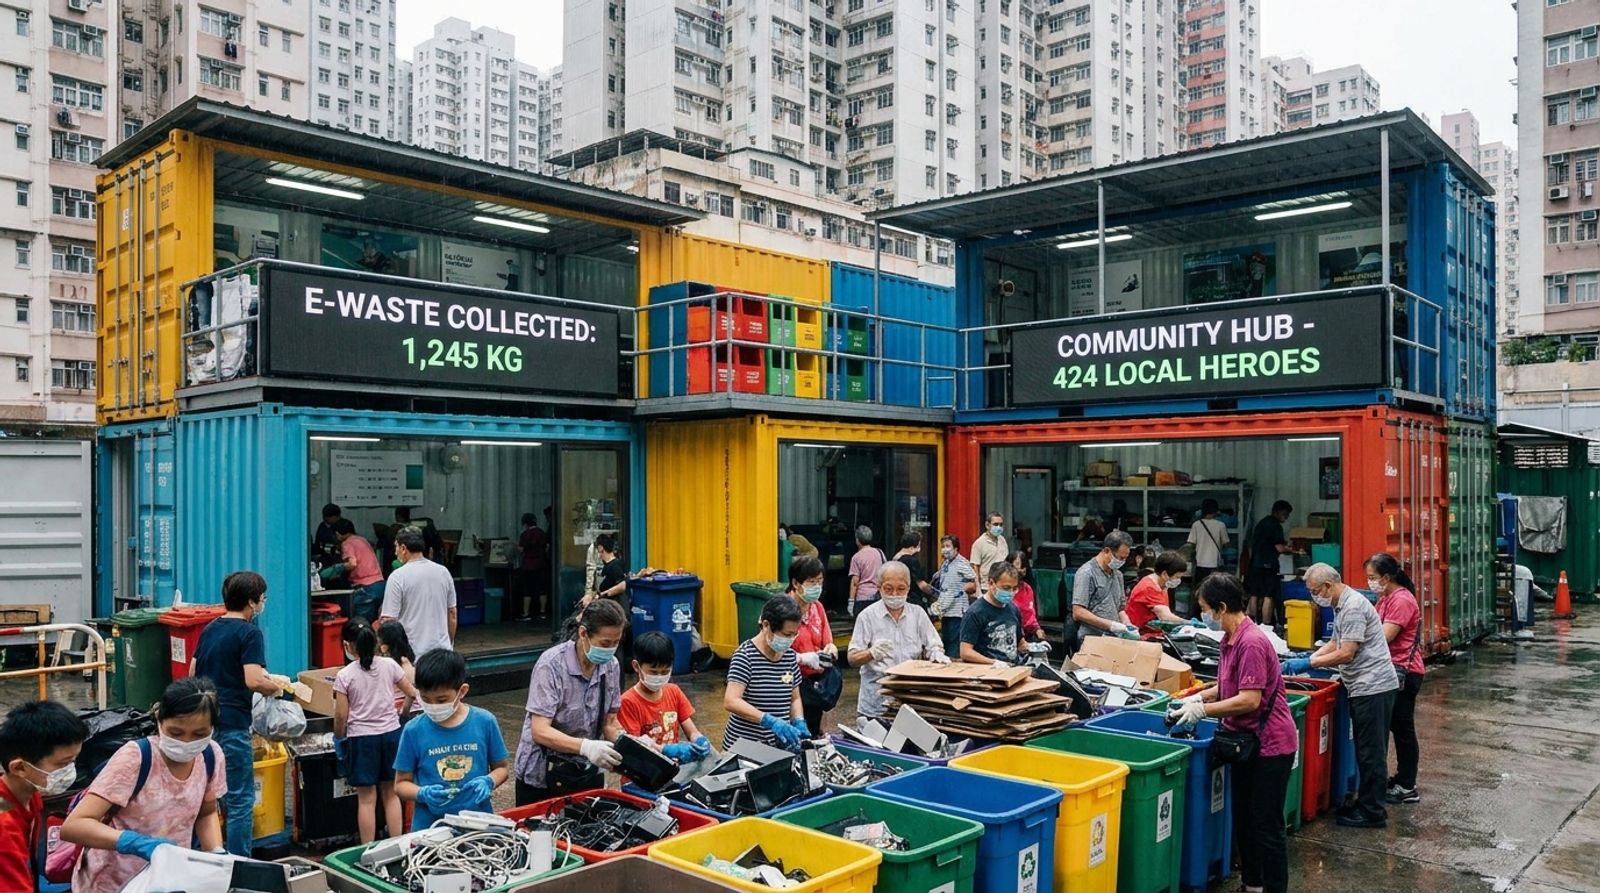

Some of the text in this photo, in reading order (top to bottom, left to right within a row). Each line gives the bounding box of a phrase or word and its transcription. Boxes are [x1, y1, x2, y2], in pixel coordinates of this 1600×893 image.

[305, 286, 597, 343] E-WASTE COLLECTED:
[1057, 320, 1224, 358] COMMUNITY
[1231, 314, 1294, 344] HUB
[402, 337, 523, 373] 1,245 KG
[1053, 346, 1320, 389] 424 LOCAL HEROES
